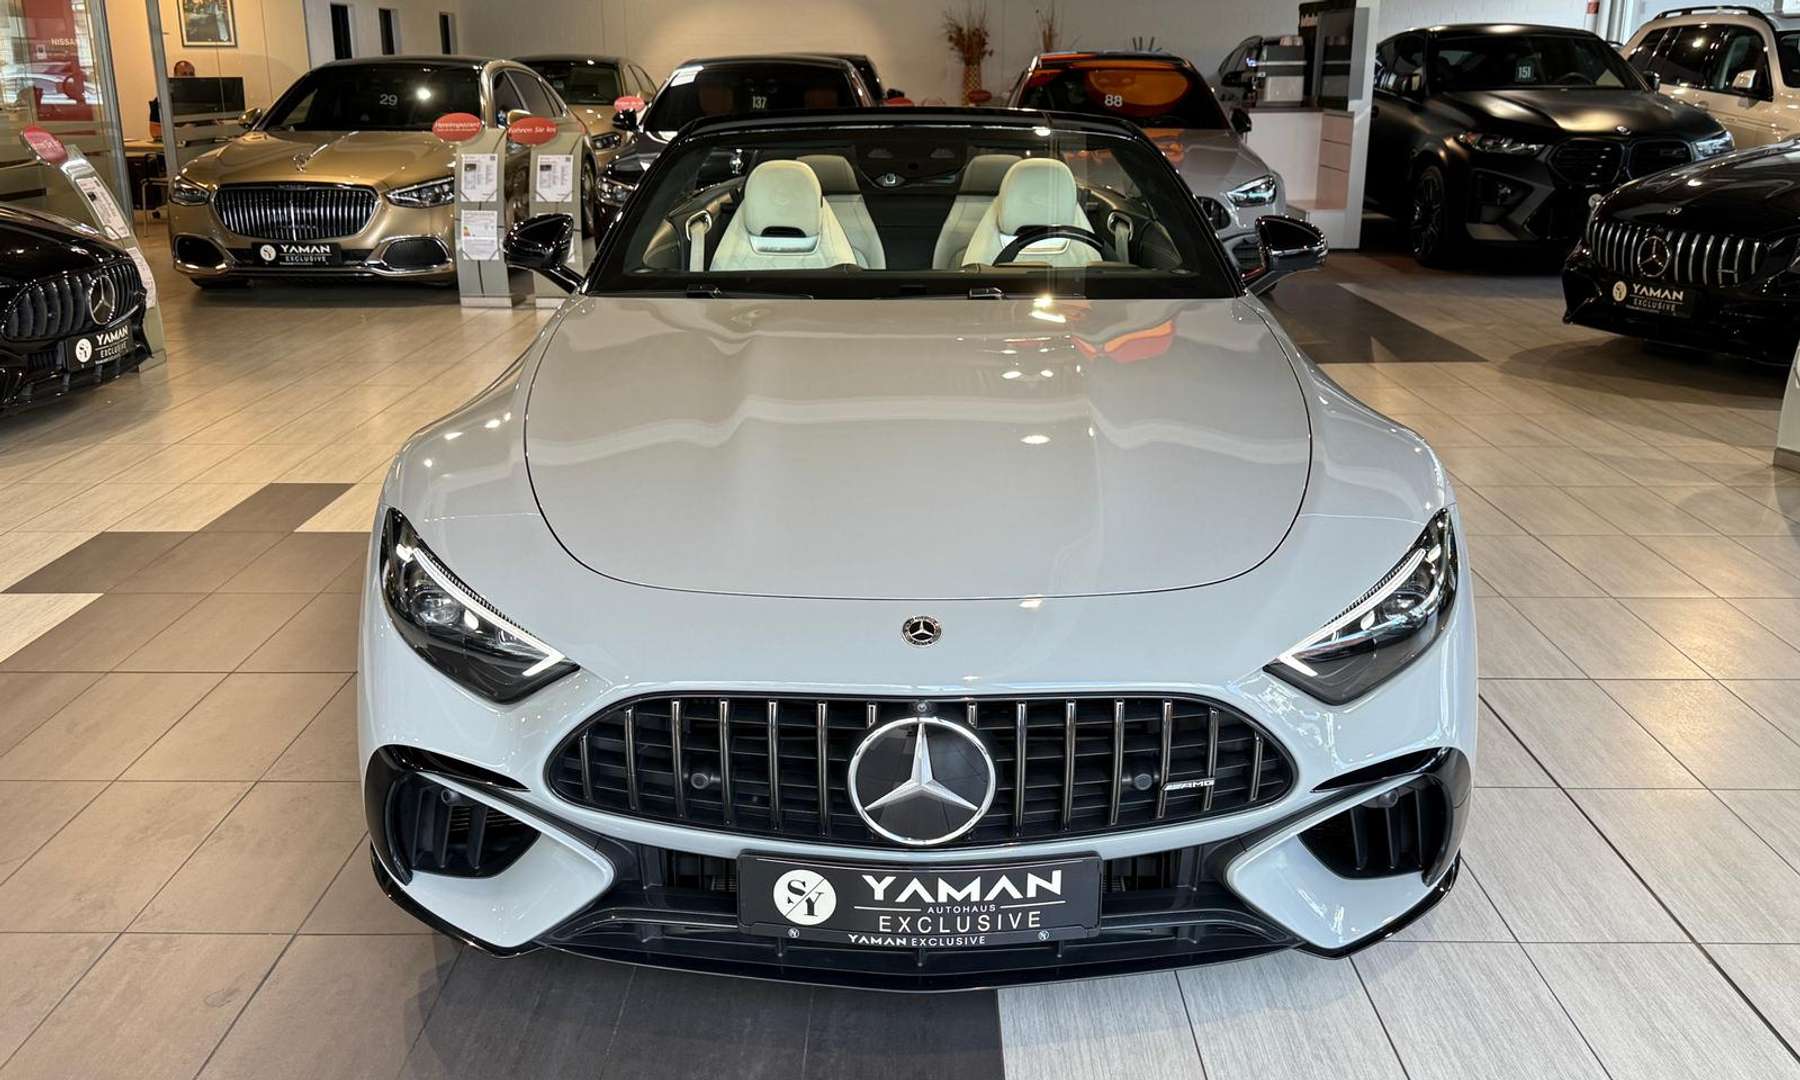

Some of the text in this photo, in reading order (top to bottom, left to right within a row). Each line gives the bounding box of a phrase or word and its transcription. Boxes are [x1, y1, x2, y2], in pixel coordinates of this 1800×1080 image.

[51, 38, 79, 46] NISSA
[1518, 66, 1532, 79] 151
[379, 94, 399, 106] 29
[752, 96, 768, 109] 137
[1105, 94, 1123, 108] 88
[280, 244, 331, 254] YAMAN
[1632, 283, 1685, 301] YAMAN
[1633, 298, 1676, 312] EXCLUSIVE
[95, 325, 129, 346] YAMAN
[862, 869, 1062, 903] YAMAN
[927, 904, 996, 914] AUTOHAUS
[879, 911, 1041, 934] EXCLUSIVE
[847, 934, 986, 947] YAMAN EXCLUSIVE
